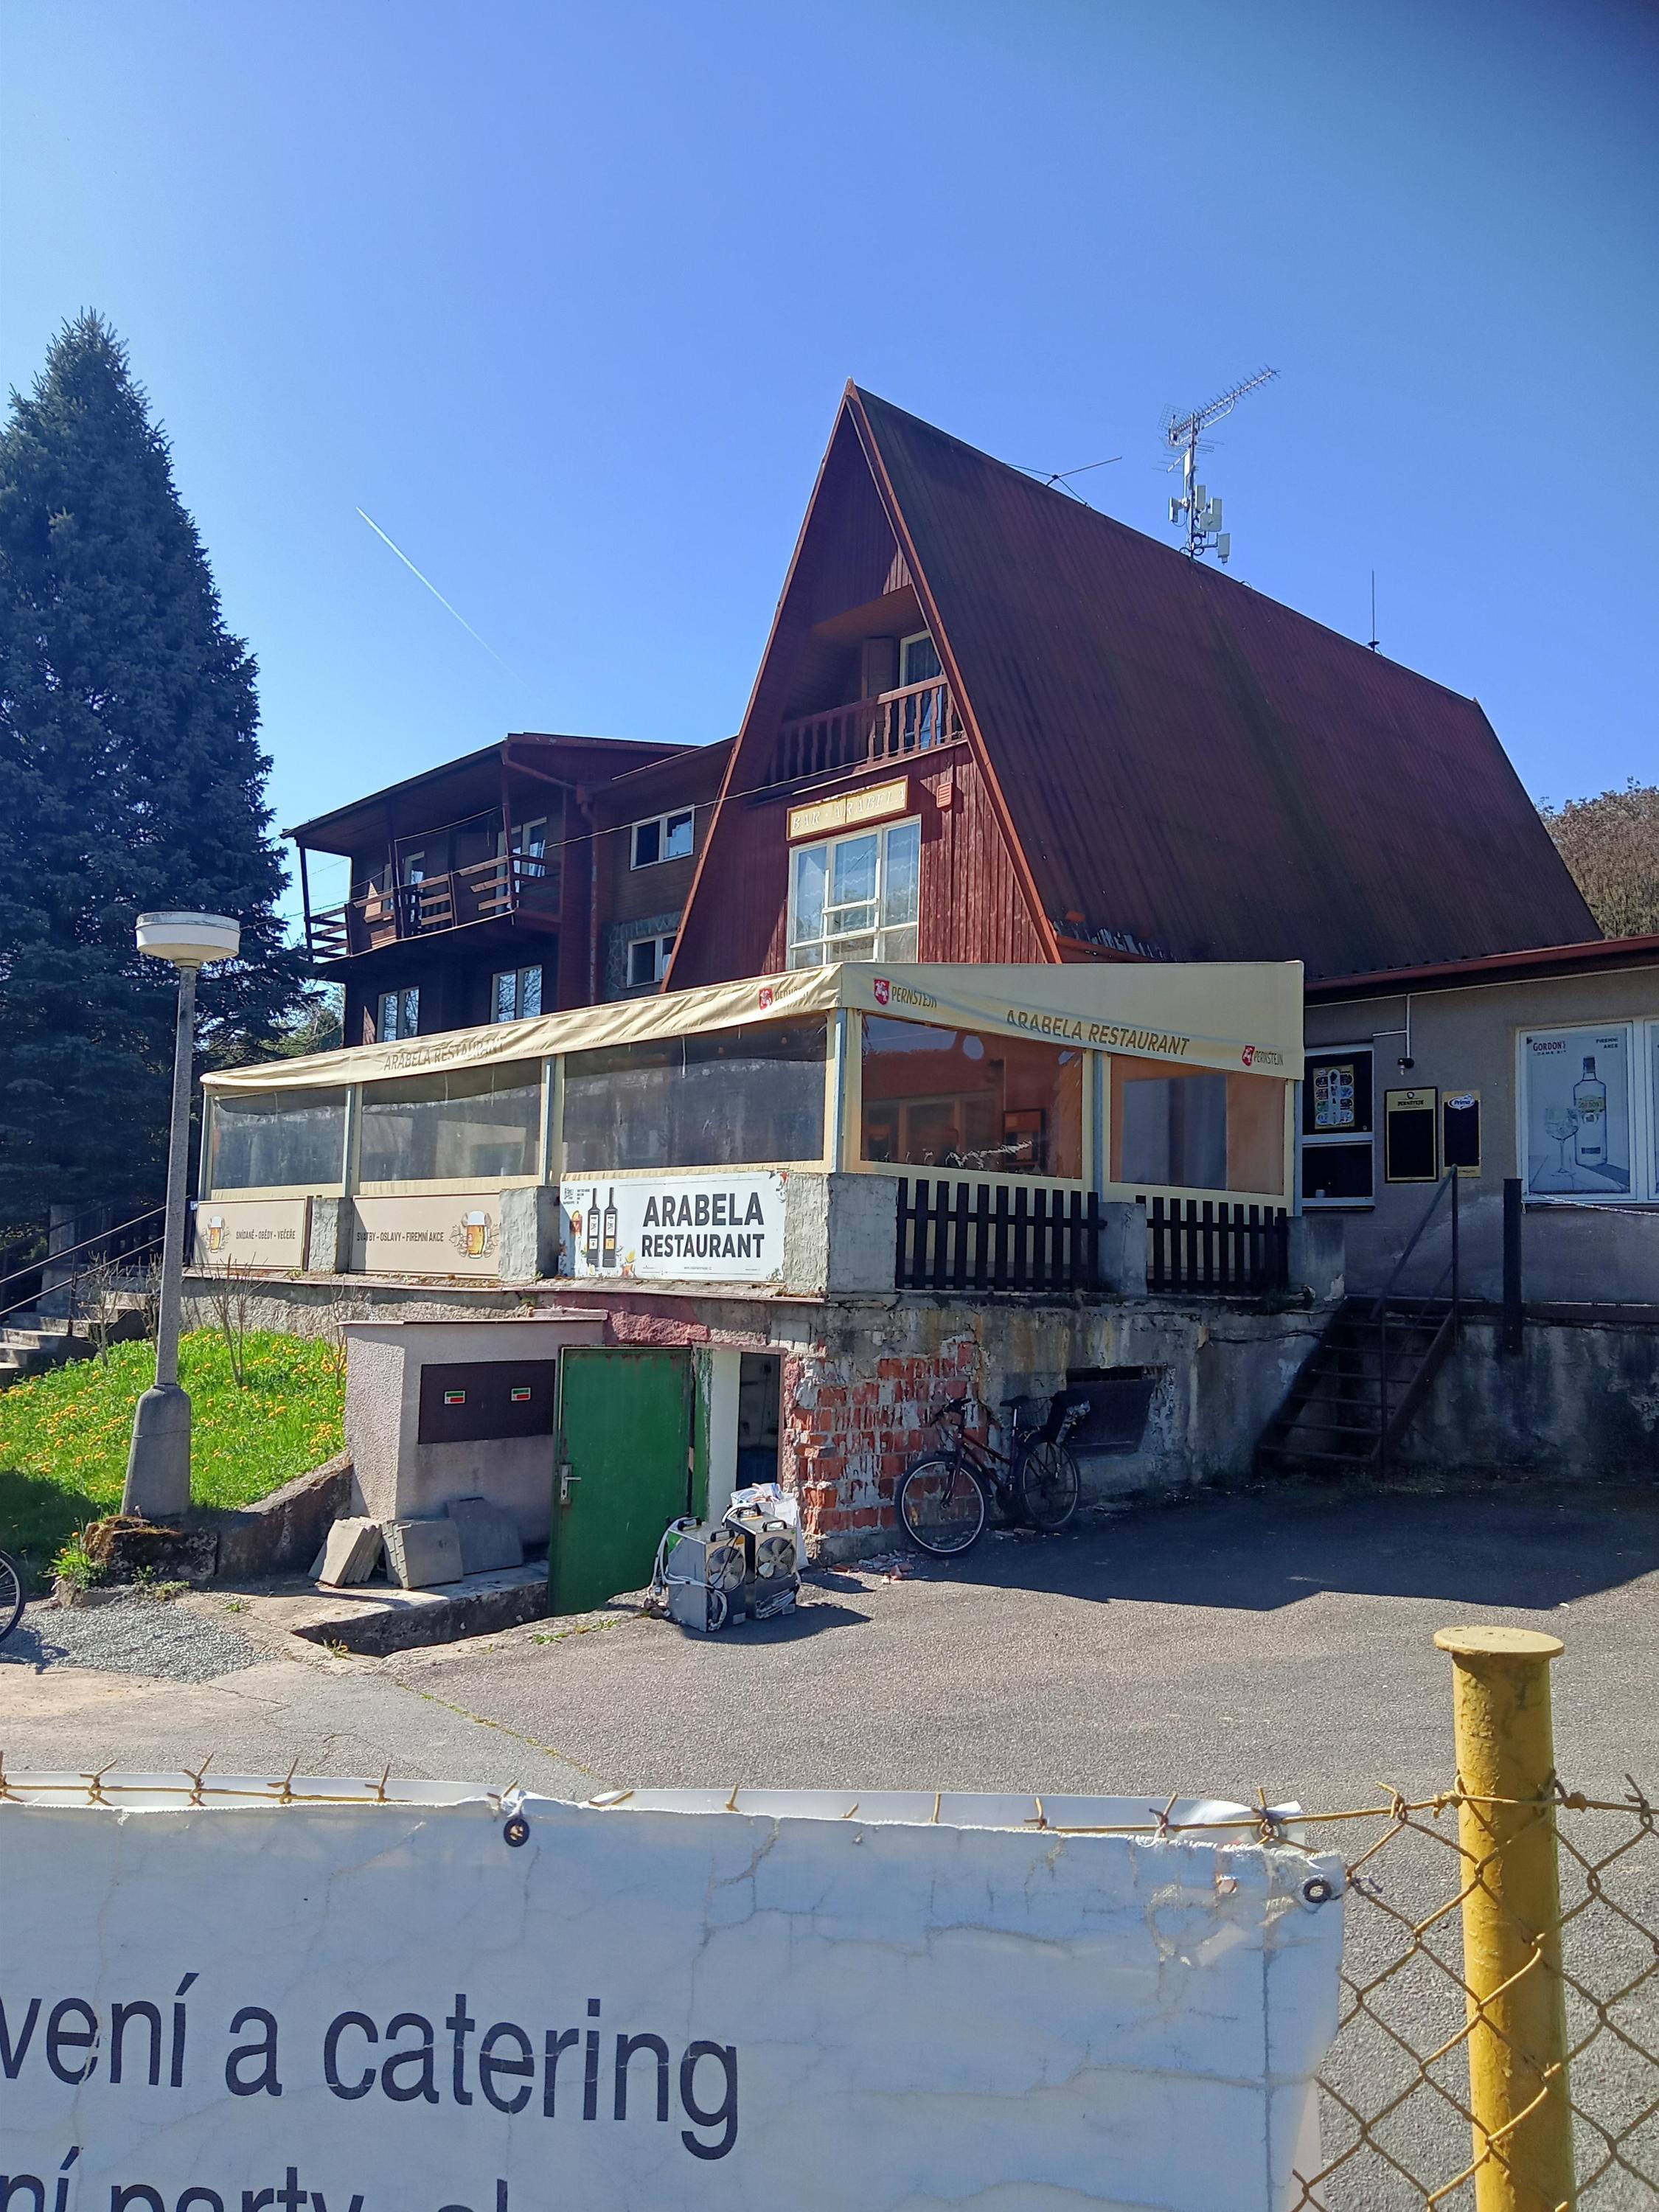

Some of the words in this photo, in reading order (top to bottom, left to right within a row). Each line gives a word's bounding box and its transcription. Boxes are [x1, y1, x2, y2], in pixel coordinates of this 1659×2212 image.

[792, 811, 821, 830] BAR
[1006, 1009, 1082, 1041] ARABELA
[1088, 1023, 1190, 1055] RESTAURANT
[384, 1048, 431, 1071] ARABELA
[642, 1192, 765, 1228] ARABELA
[357, 1231, 376, 1242] SVATBY
[380, 1231, 402, 1242] OSLAVY
[406, 1230, 428, 1242] FIREMNÍ
[428, 1231, 445, 1242] AKCE
[641, 1233, 765, 1259] RESTAURANT
[224, 2006, 283, 2097] a
[323, 1993, 738, 2160] catering
